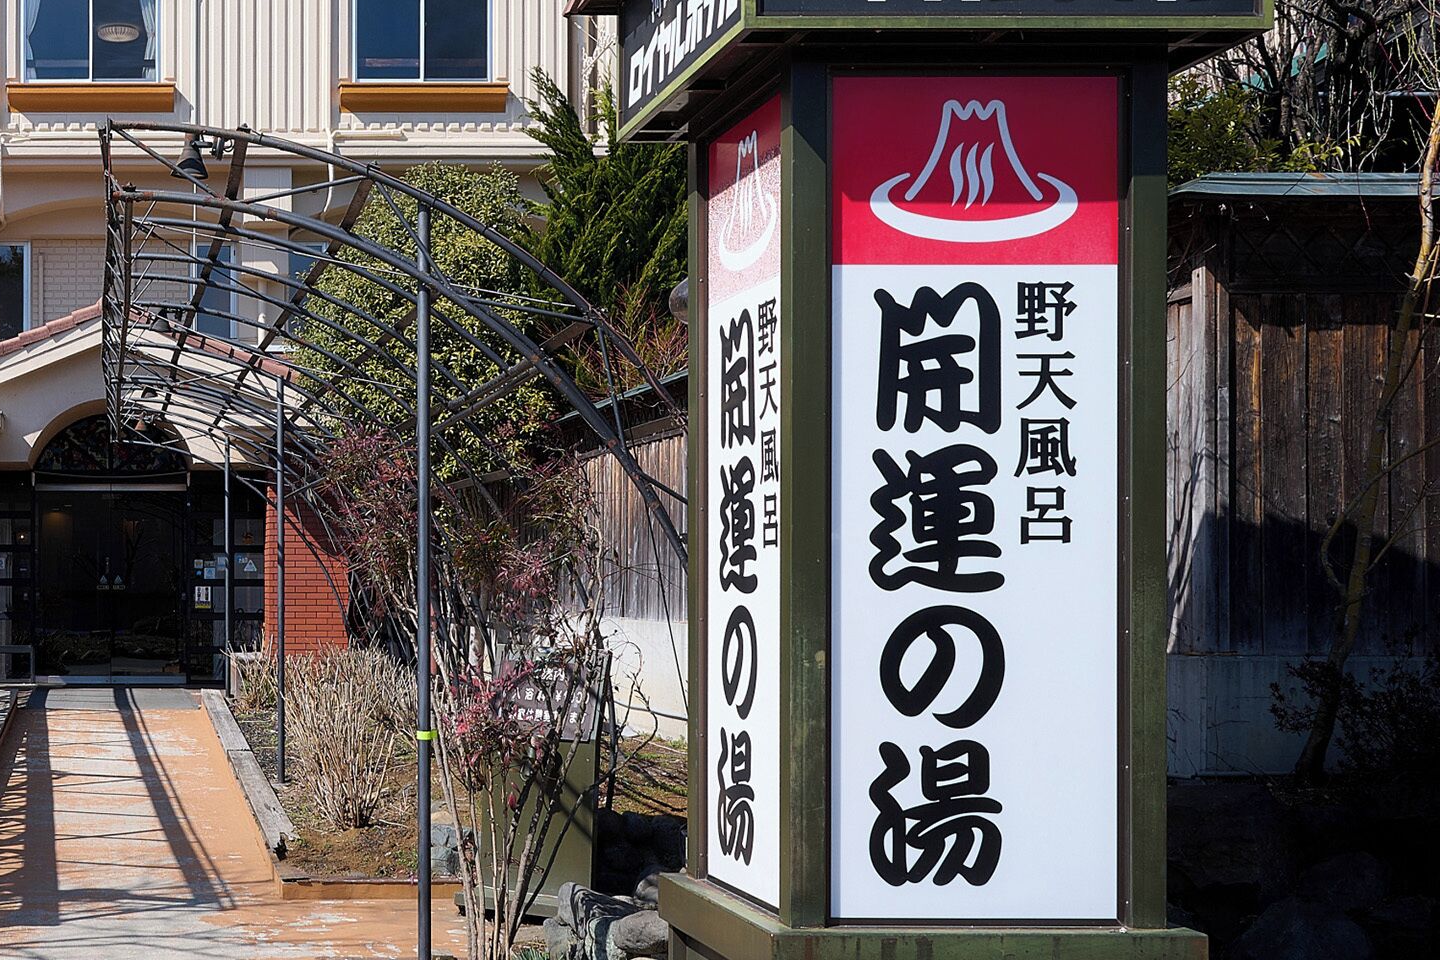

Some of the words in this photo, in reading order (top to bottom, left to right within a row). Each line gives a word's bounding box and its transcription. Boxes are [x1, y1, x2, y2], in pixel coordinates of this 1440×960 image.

[718, 308, 758, 865] 開運の湯
[758, 296, 779, 548] 野天風呂
[869, 282, 1006, 886] 開運の湯
[1013, 281, 1077, 544] 野天風呂
